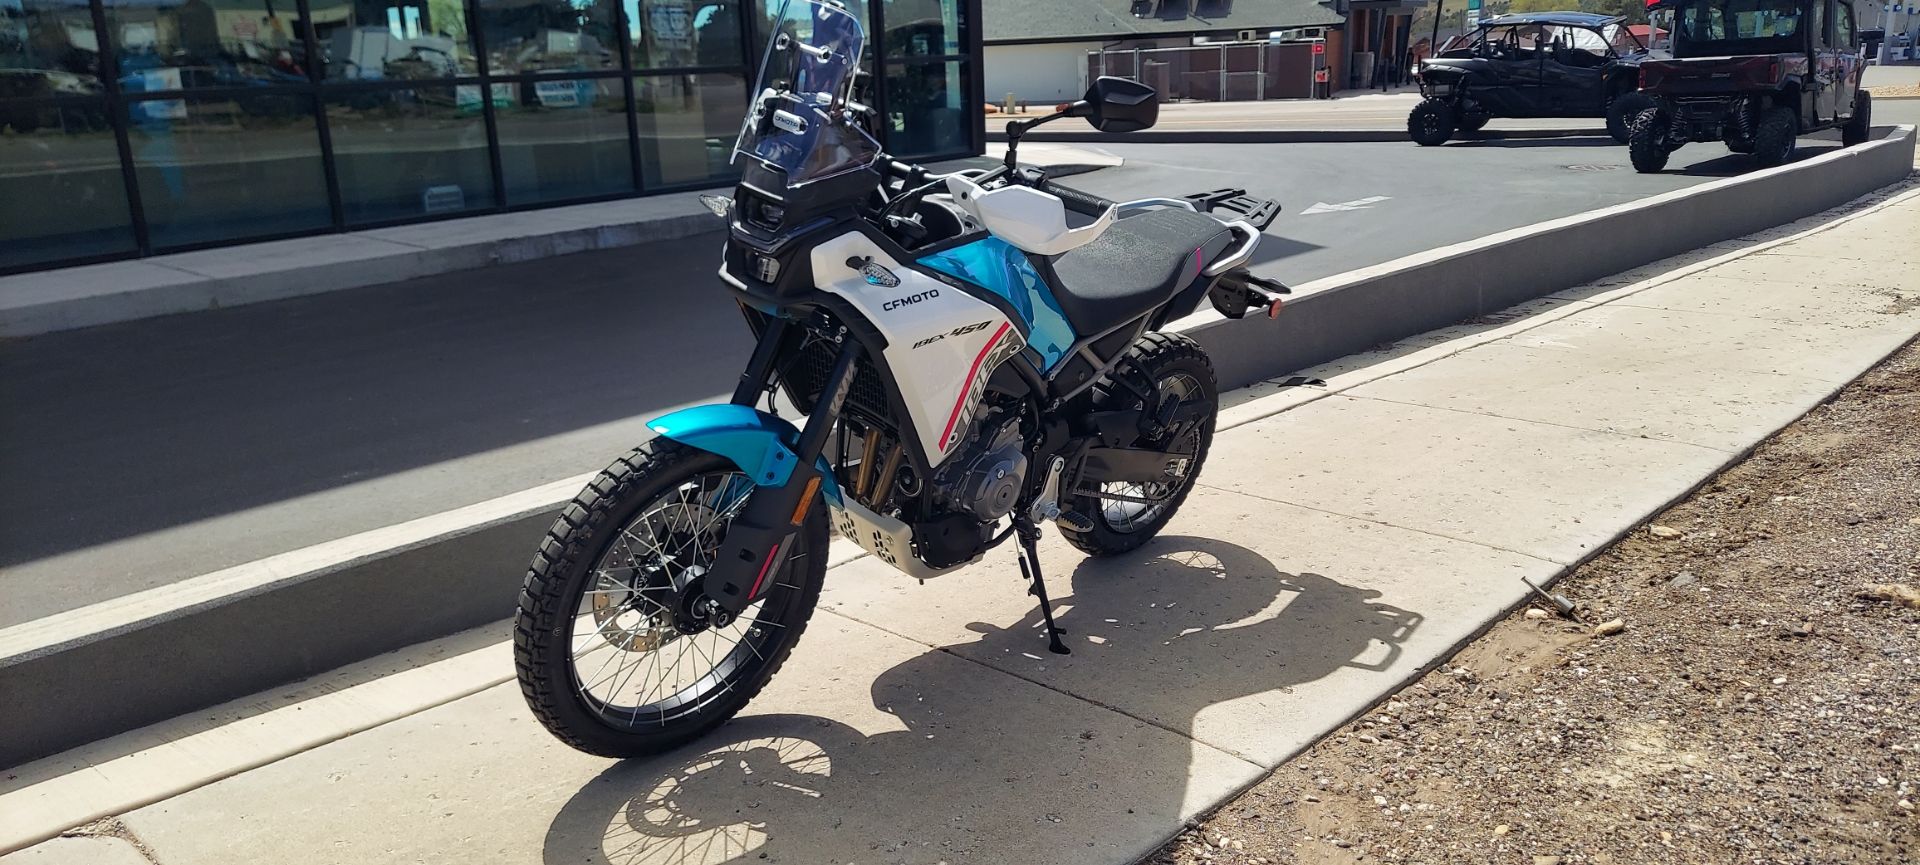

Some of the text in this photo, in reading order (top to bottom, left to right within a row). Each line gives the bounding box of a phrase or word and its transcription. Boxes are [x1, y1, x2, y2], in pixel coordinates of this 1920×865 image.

[882, 289, 940, 312] CFMOTO
[912, 320, 993, 350] IBEX 450
[962, 332, 1014, 426] IBEX
